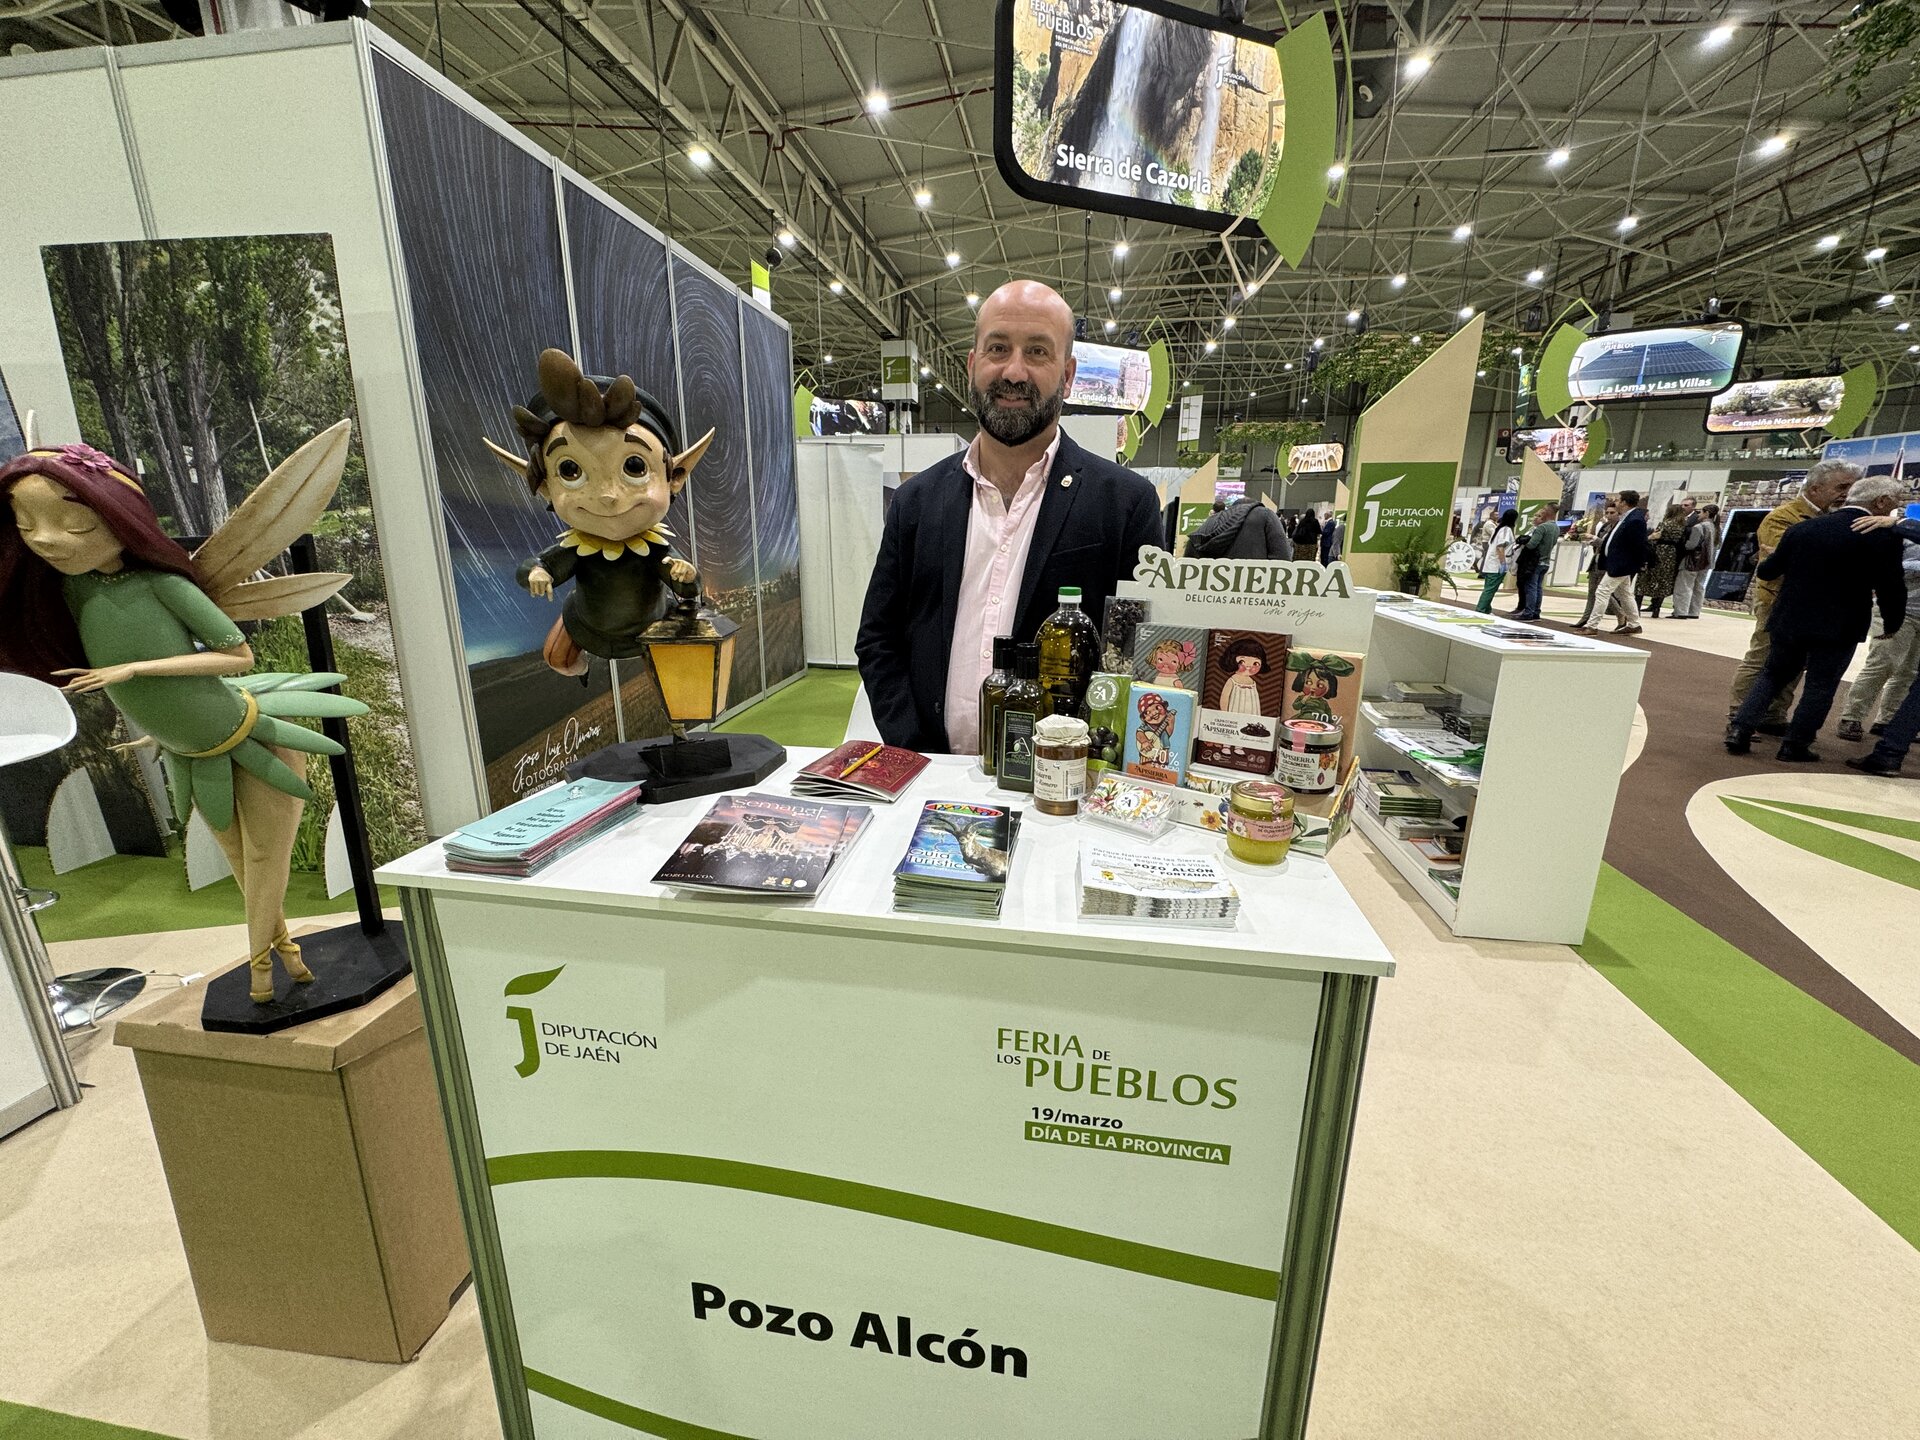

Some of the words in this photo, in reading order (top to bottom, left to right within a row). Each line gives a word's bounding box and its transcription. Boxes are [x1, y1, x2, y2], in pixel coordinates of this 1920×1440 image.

[1037, 12, 1094, 40] PUEBLOS
[1056, 144, 1114, 176] Sierra
[1118, 156, 1142, 181] de
[1146, 163, 1212, 194] Cazorla
[1600, 385, 1613, 394] La
[1615, 382, 1645, 393] Loma
[1648, 383, 1656, 392] y
[1657, 380, 1678, 390] Las
[1679, 377, 1712, 388] Villas
[1078, 393, 1107, 402] Condado
[1732, 418, 1772, 427] Campiña
[1773, 418, 1801, 426] Norte
[1802, 416, 1815, 424] de
[1382, 507, 1444, 517] DIPUTACIÓN
[1380, 519, 1394, 528] DE
[1395, 518, 1422, 528] JAÉN
[1139, 558, 1350, 598] APISIERRA
[1185, 593, 1228, 604] DELICIAS
[1229, 596, 1286, 608] ARTESANAS
[1264, 607, 1283, 616] con
[1287, 608, 1325, 626] origen
[1202, 723, 1240, 736] APISIERRA
[1280, 750, 1316, 764] APISIERRA
[1093, 848, 1120, 856] Parque
[1121, 851, 1152, 860] Natural
[1135, 858, 1165, 866] Segura
[1134, 863, 1167, 872] POZO
[542, 1022, 658, 1050] DIPUTACIÓN
[997, 1028, 1084, 1058] FERIA
[1092, 1050, 1111, 1061] DE
[545, 1042, 570, 1057] DE
[574, 1047, 621, 1064] JAÉN
[996, 1054, 1021, 1066] LOS
[1025, 1057, 1238, 1110] PUEBLOS
[1031, 1106, 1124, 1130] 19/marzo
[1031, 1125, 1062, 1142] DÍA
[1067, 1130, 1090, 1146] DE
[1095, 1134, 1118, 1149] LA
[1122, 1137, 1224, 1162] PROVINCIA
[691, 1281, 834, 1342] Pozo
[849, 1311, 1028, 1379] Alcón
